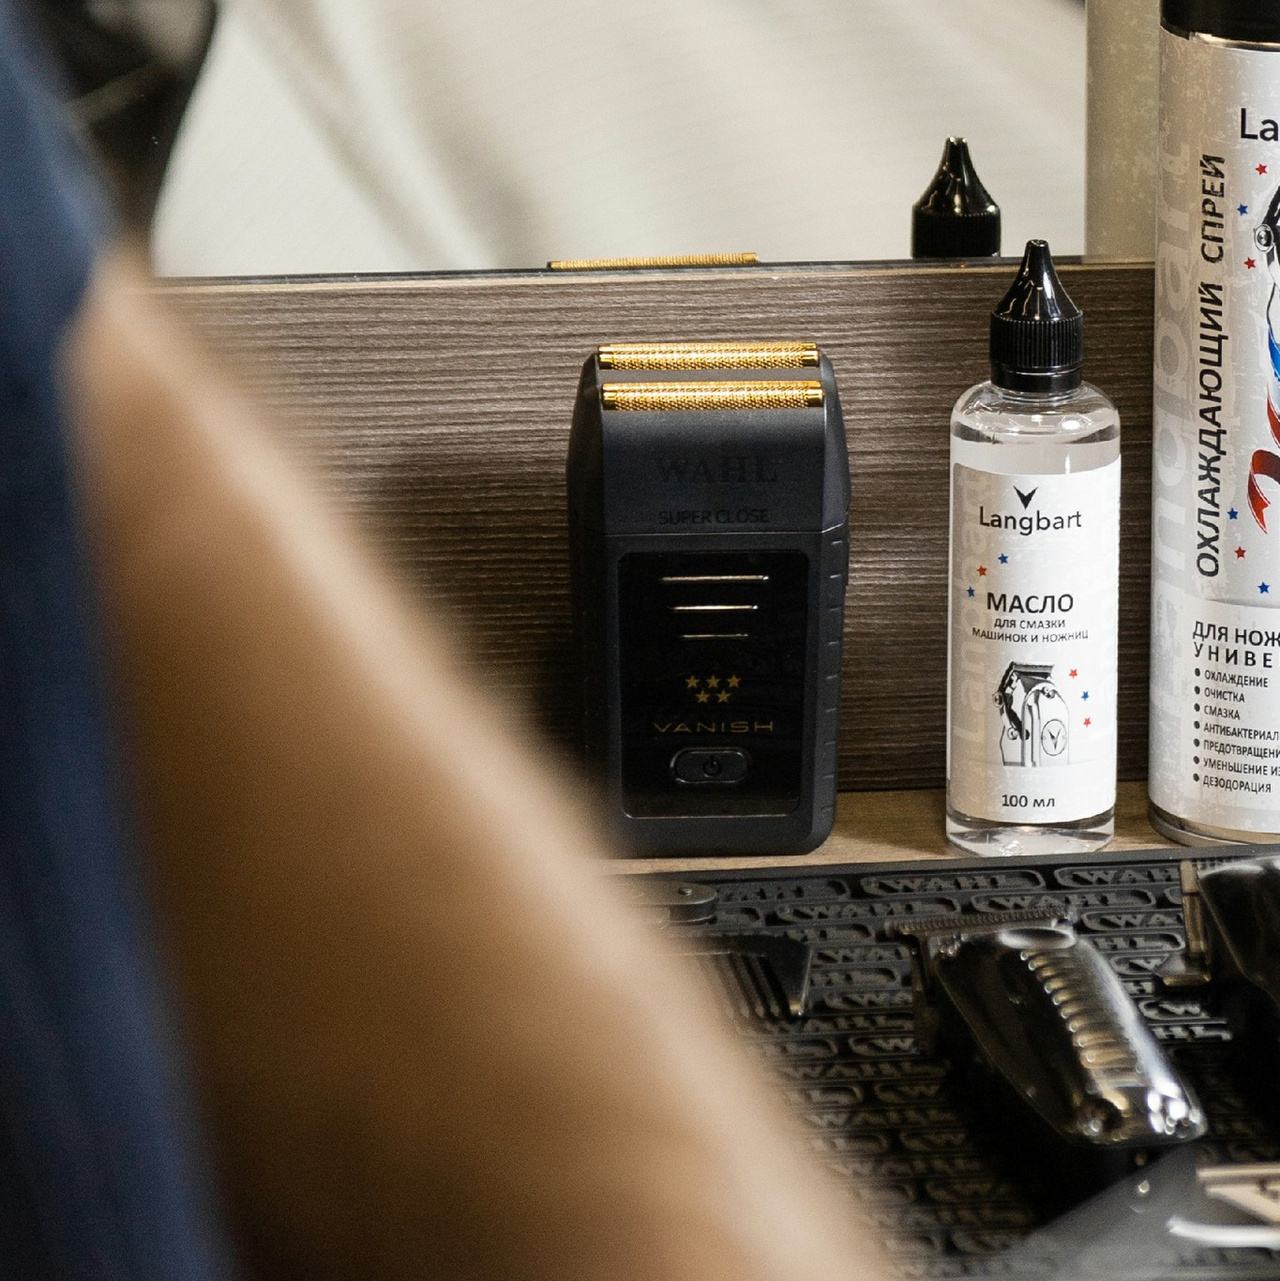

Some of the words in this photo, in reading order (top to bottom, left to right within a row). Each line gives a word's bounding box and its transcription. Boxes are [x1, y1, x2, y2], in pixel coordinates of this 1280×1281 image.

[1199, 153, 1228, 265] СПРЕЙ
[1196, 282, 1229, 579] ОХЛАЖДАЮЩИЙ
[655, 455, 778, 483] WAHL
[658, 509, 713, 526] SUPER
[715, 507, 771, 524] CLOSE
[979, 505, 1082, 537] Langbart
[986, 591, 1075, 614] МАСЛО
[993, 618, 1017, 629] ДЛЯ
[1019, 619, 1066, 630] СМАЗКИ
[1192, 620, 1229, 643] ДЛЯ
[971, 627, 1029, 643] МАШИНОК
[1030, 634, 1039, 643] И
[1041, 629, 1089, 643] НОЖНИЦ
[1203, 669, 1269, 688] ОХЛАЖДЕНИЕ
[1203, 687, 1246, 703] ОЧИСТКА
[1203, 704, 1241, 721] СМАЗКА
[651, 720, 775, 734] VANISH
[1202, 757, 1269, 776] УМЕНЬШЕНИЕ
[1202, 775, 1272, 794] ДЕЗОДОРАЦИЯ
[1001, 792, 1028, 808] 100
[1032, 796, 1056, 809] мл
[875, 873, 1018, 895] WAHL
[988, 891, 1133, 912] WAHL
[790, 901, 939, 922] WAHL
